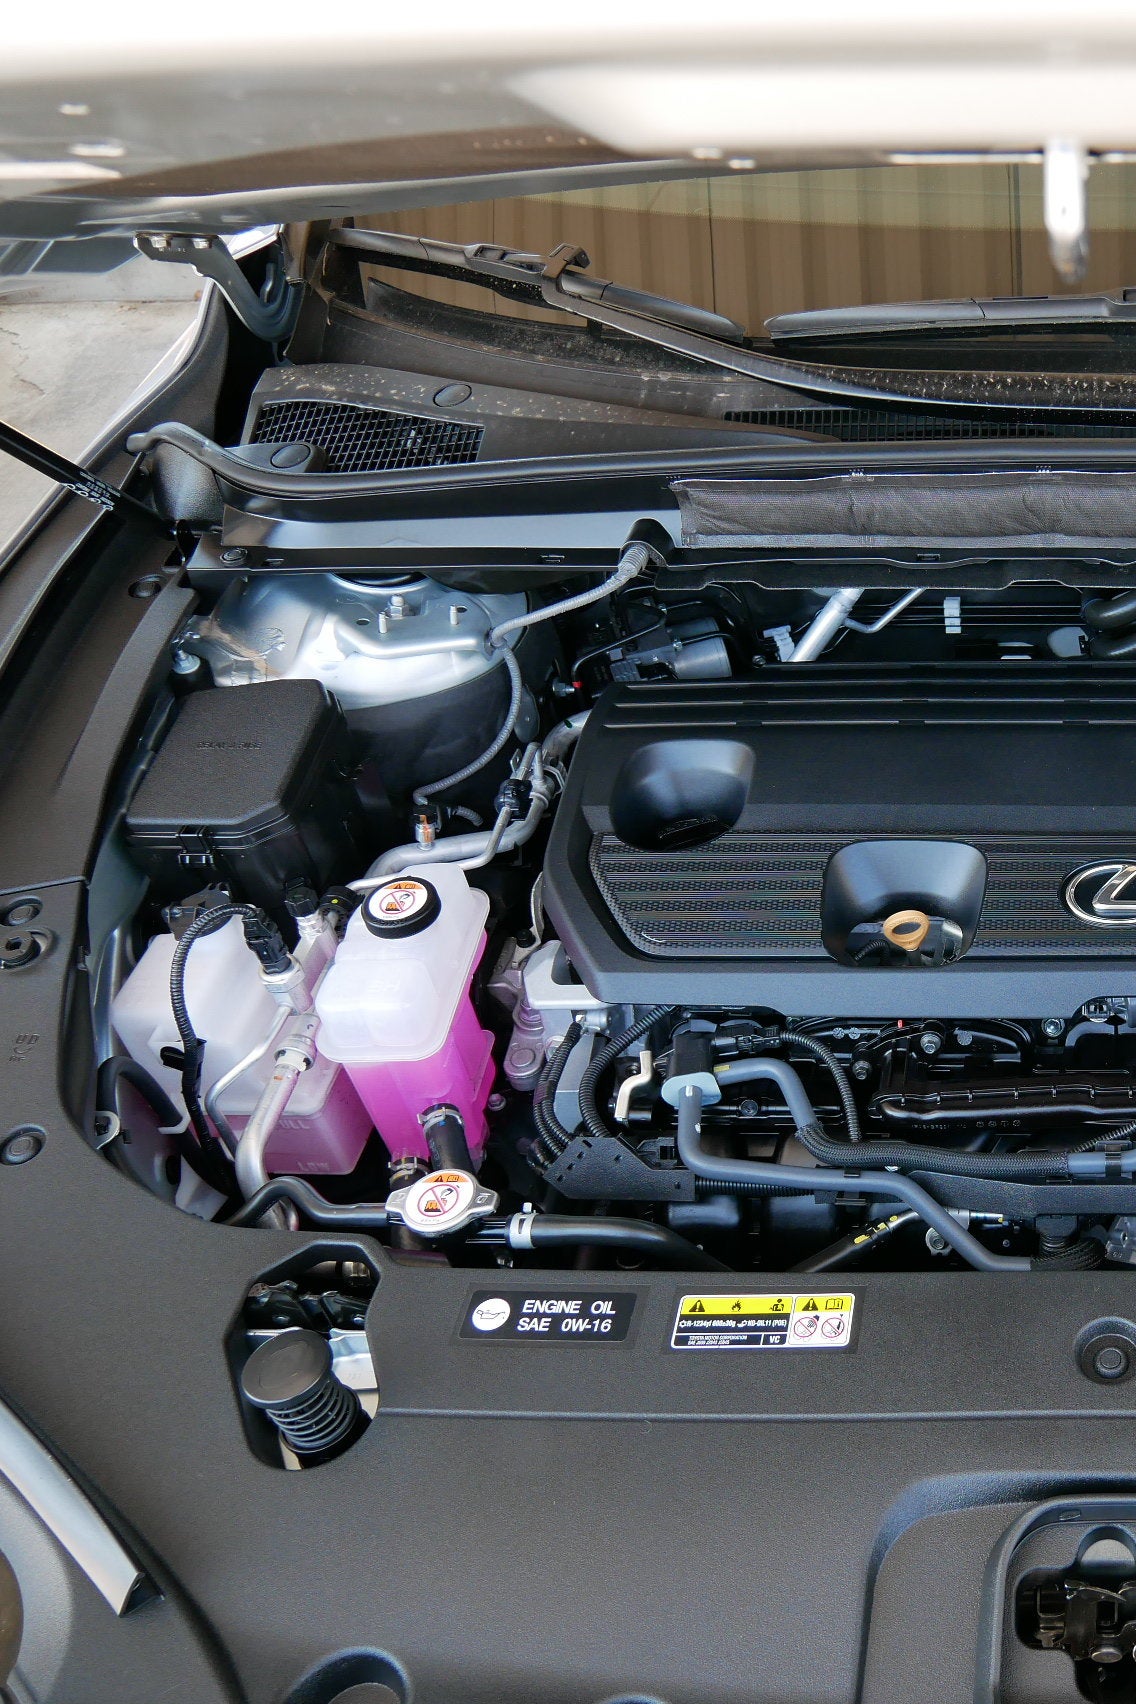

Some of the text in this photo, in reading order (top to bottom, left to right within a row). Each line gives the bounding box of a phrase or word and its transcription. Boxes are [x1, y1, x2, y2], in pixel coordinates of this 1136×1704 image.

[521, 1299, 616, 1315] ENGINE OIL
[517, 1317, 612, 1333] SAE 0W-16
[772, 1320, 787, 1328] (POE)
[769, 1335, 781, 1344] VC
